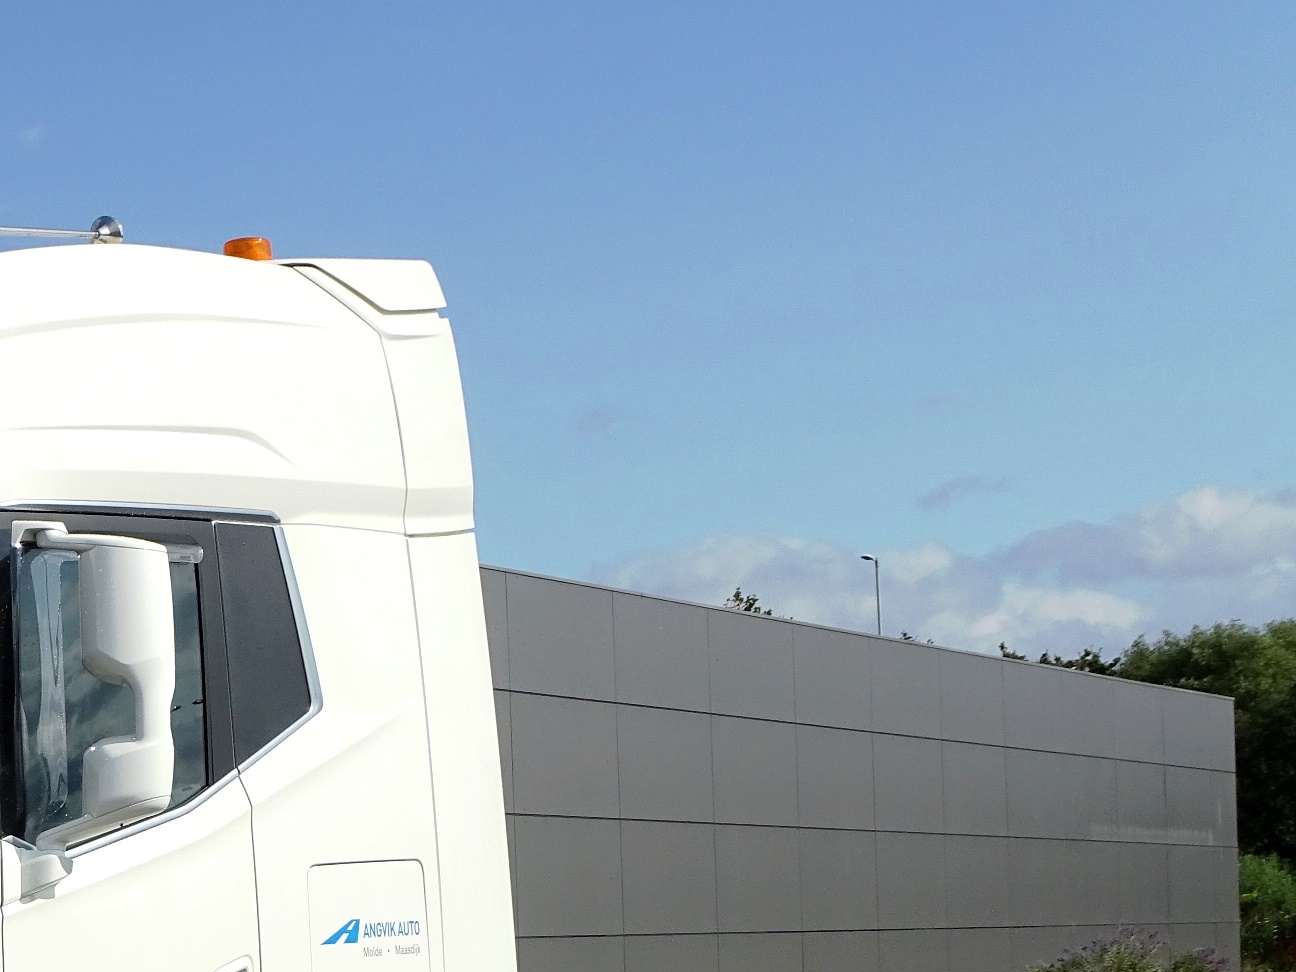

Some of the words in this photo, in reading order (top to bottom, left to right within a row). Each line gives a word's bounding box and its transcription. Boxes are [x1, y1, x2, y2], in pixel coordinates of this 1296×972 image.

[363, 921, 396, 938] ANGVIK
[397, 920, 420, 936] AUTO
[363, 946, 382, 957] Molde
